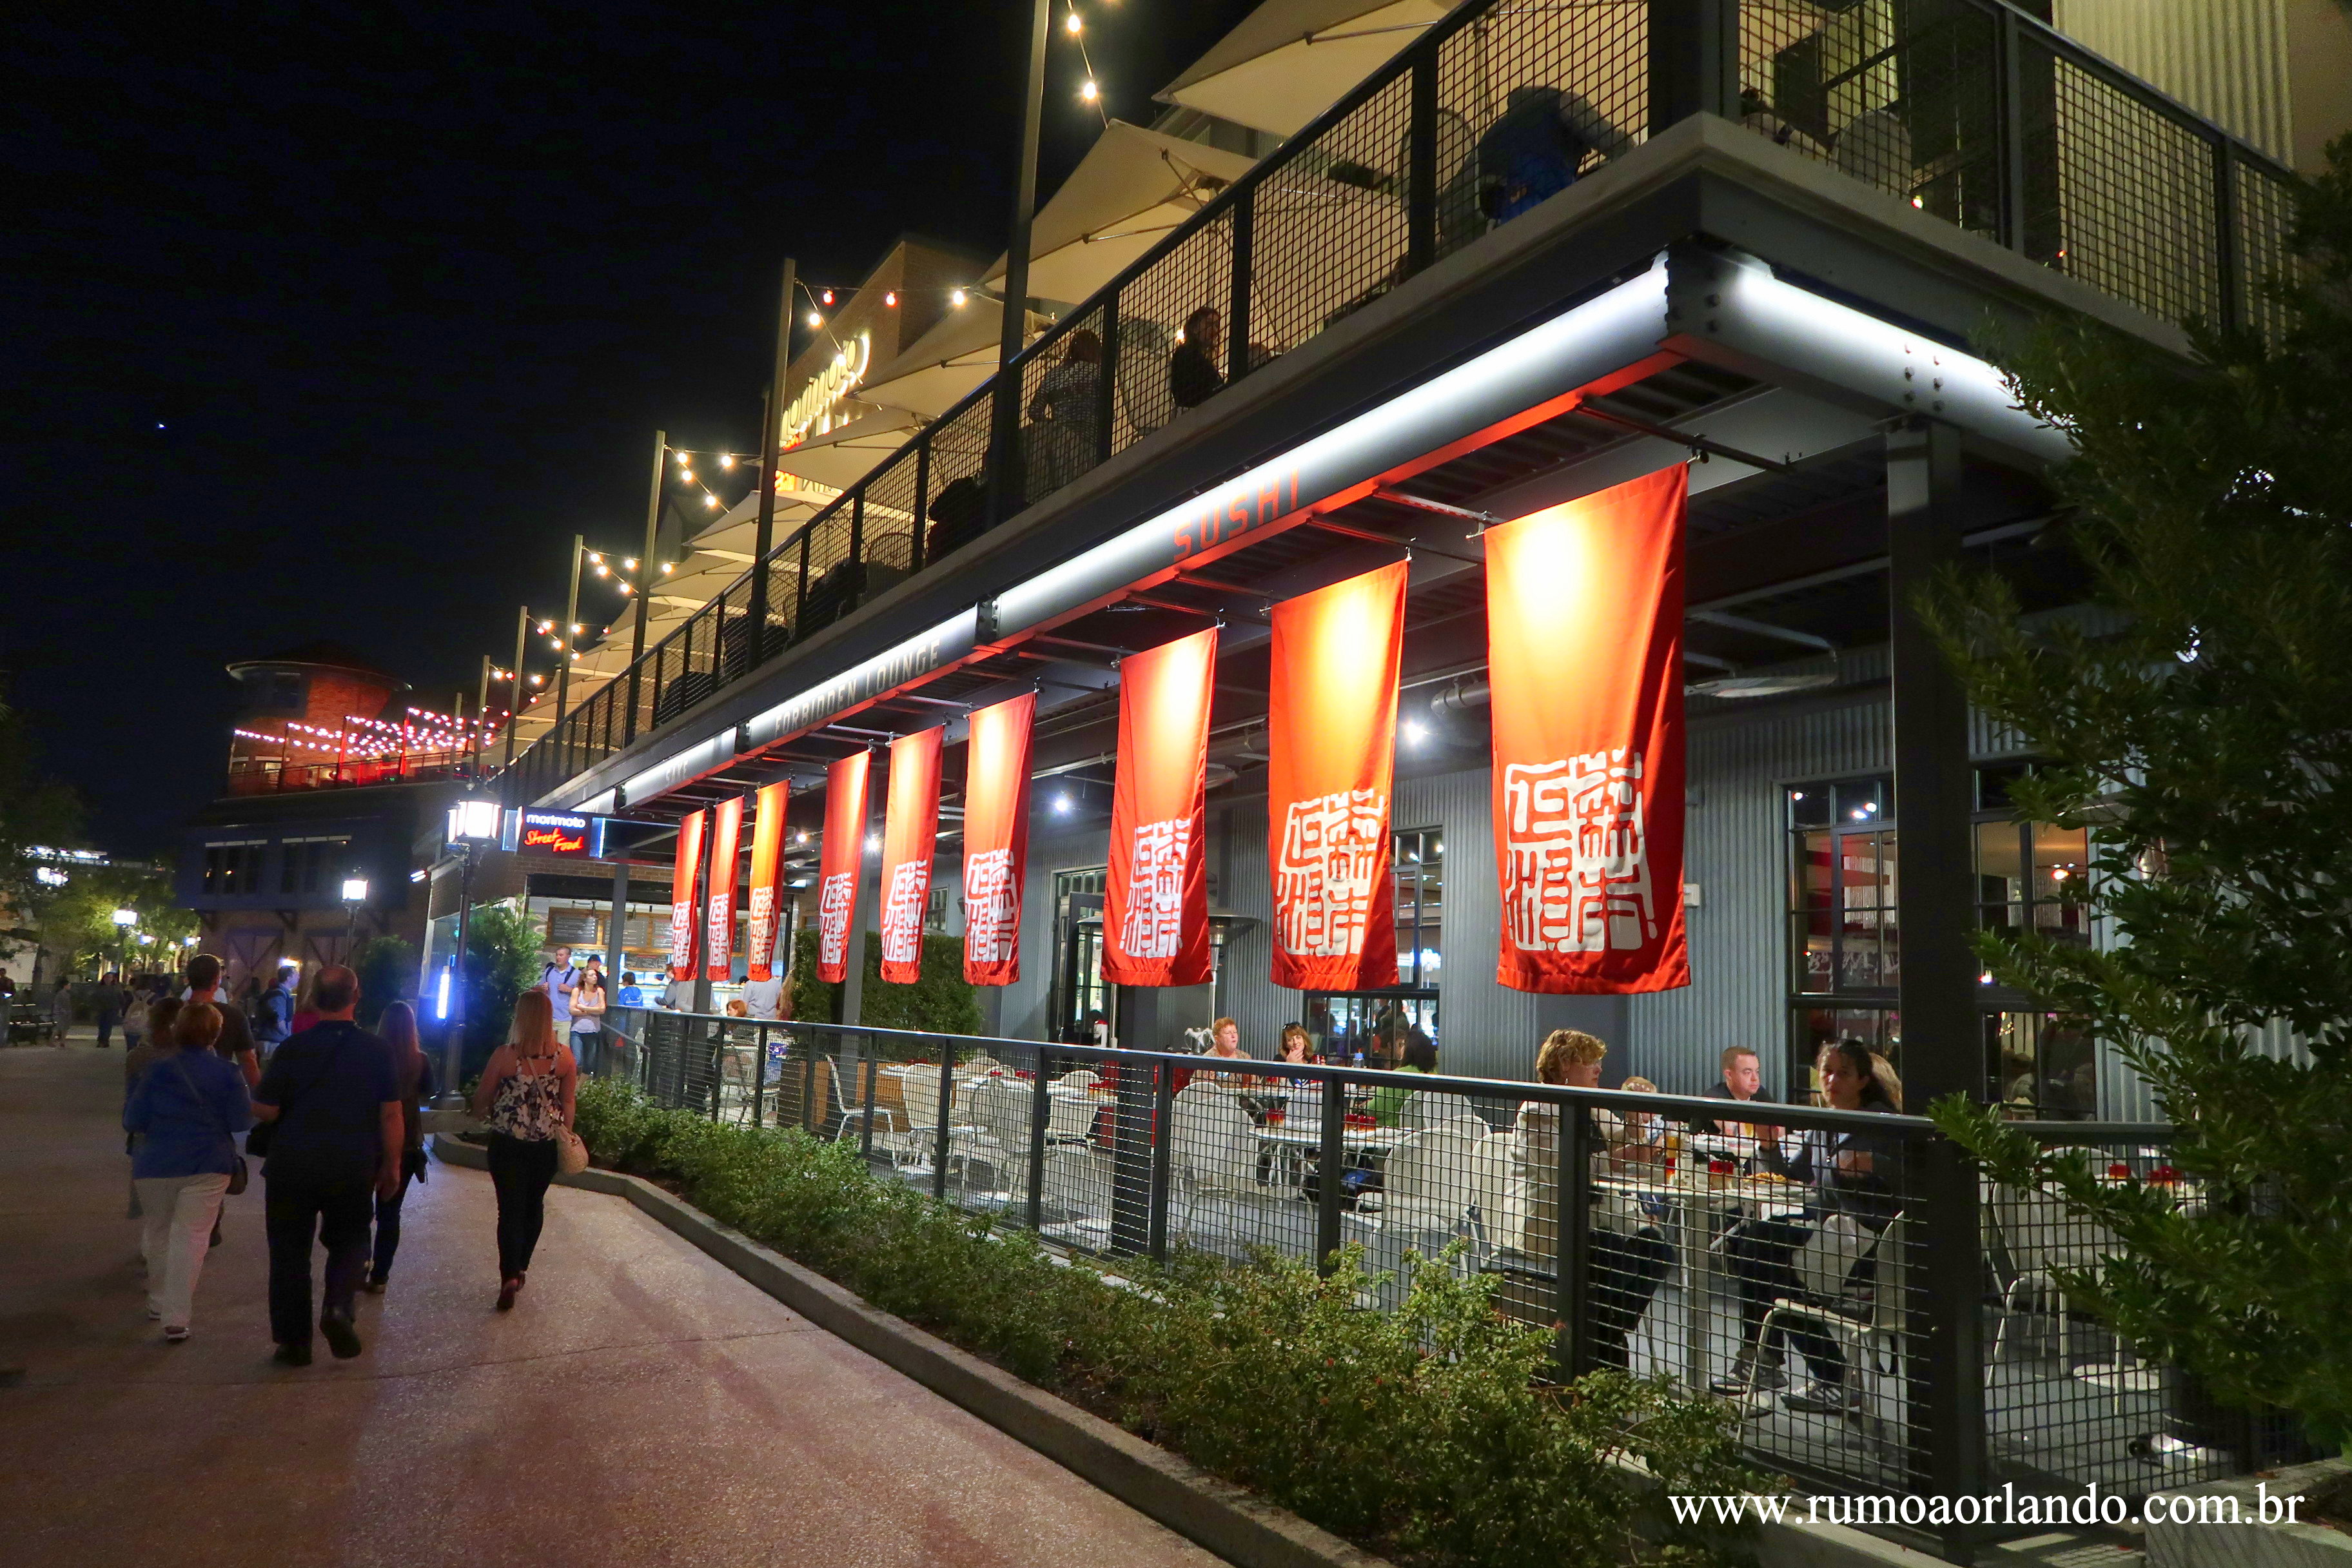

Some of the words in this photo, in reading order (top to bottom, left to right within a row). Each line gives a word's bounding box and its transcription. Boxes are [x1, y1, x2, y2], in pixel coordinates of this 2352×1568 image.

[1174, 468, 1299, 562] SUSHI
[776, 678, 857, 736] FORBIDDEN
[865, 638, 941, 698] LOUNGE
[526, 814, 585, 828] morimoto
[524, 828, 562, 846] Street
[553, 836, 585, 852] Food
